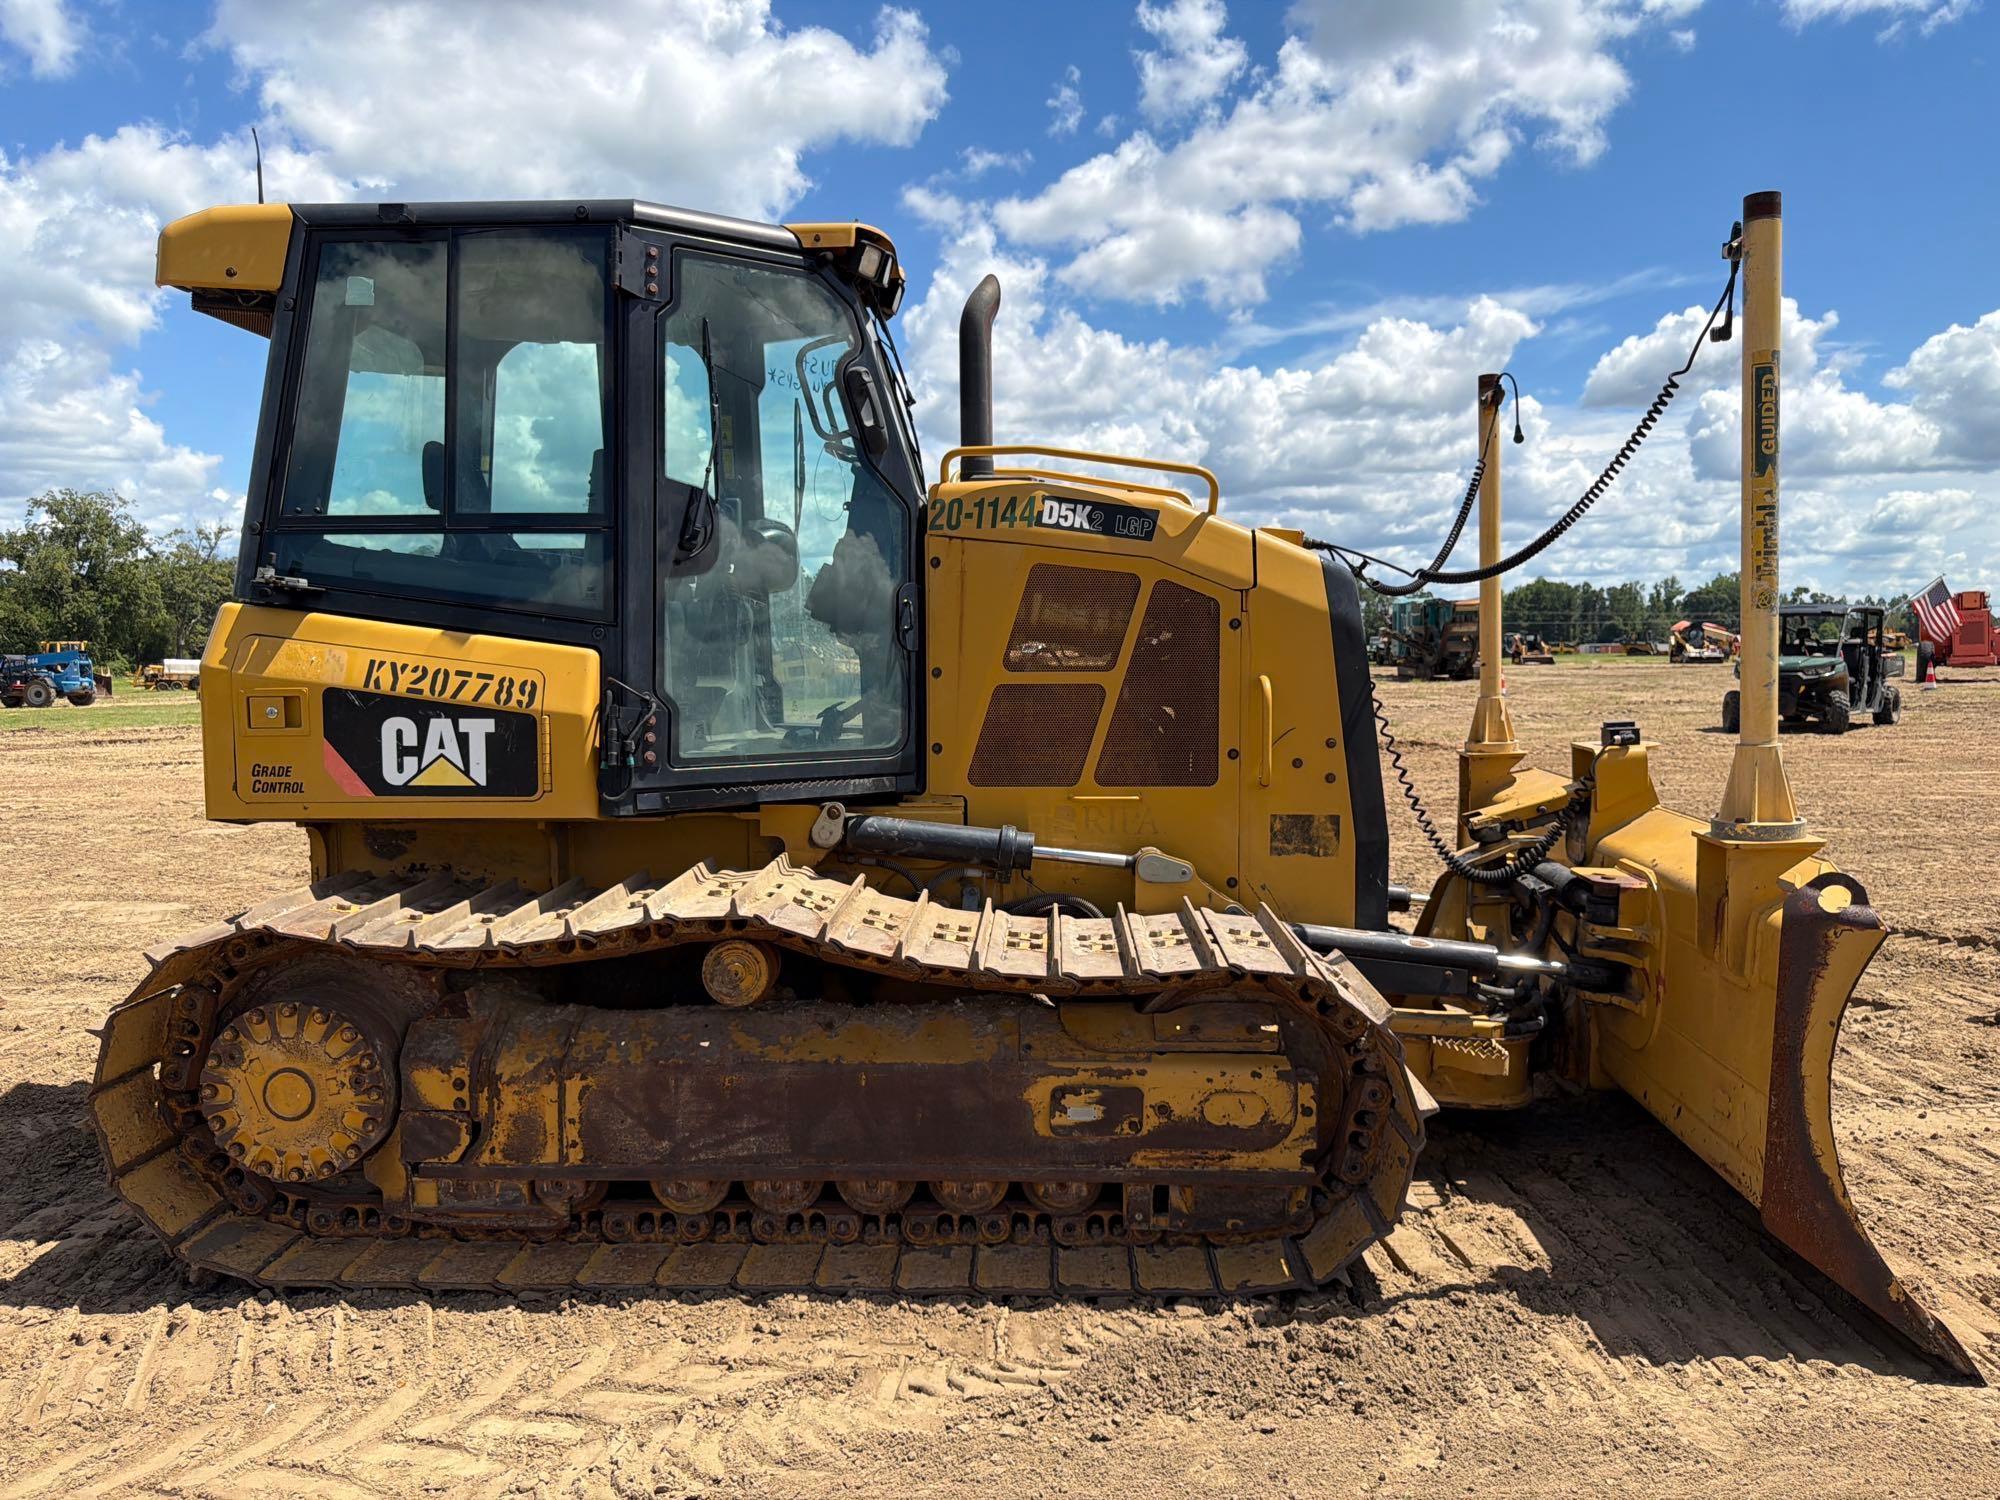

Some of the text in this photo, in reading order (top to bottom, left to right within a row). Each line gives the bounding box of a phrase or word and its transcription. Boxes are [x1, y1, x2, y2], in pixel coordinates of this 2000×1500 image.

[1761, 373, 1777, 455] GUIDED
[928, 495, 1036, 531] 20-1144
[1115, 514, 1153, 538] LGP
[363, 659, 538, 709] KY207789
[251, 763, 292, 778] GRADE
[381, 716, 495, 787] CAT
[252, 779, 305, 794] CONTROL
